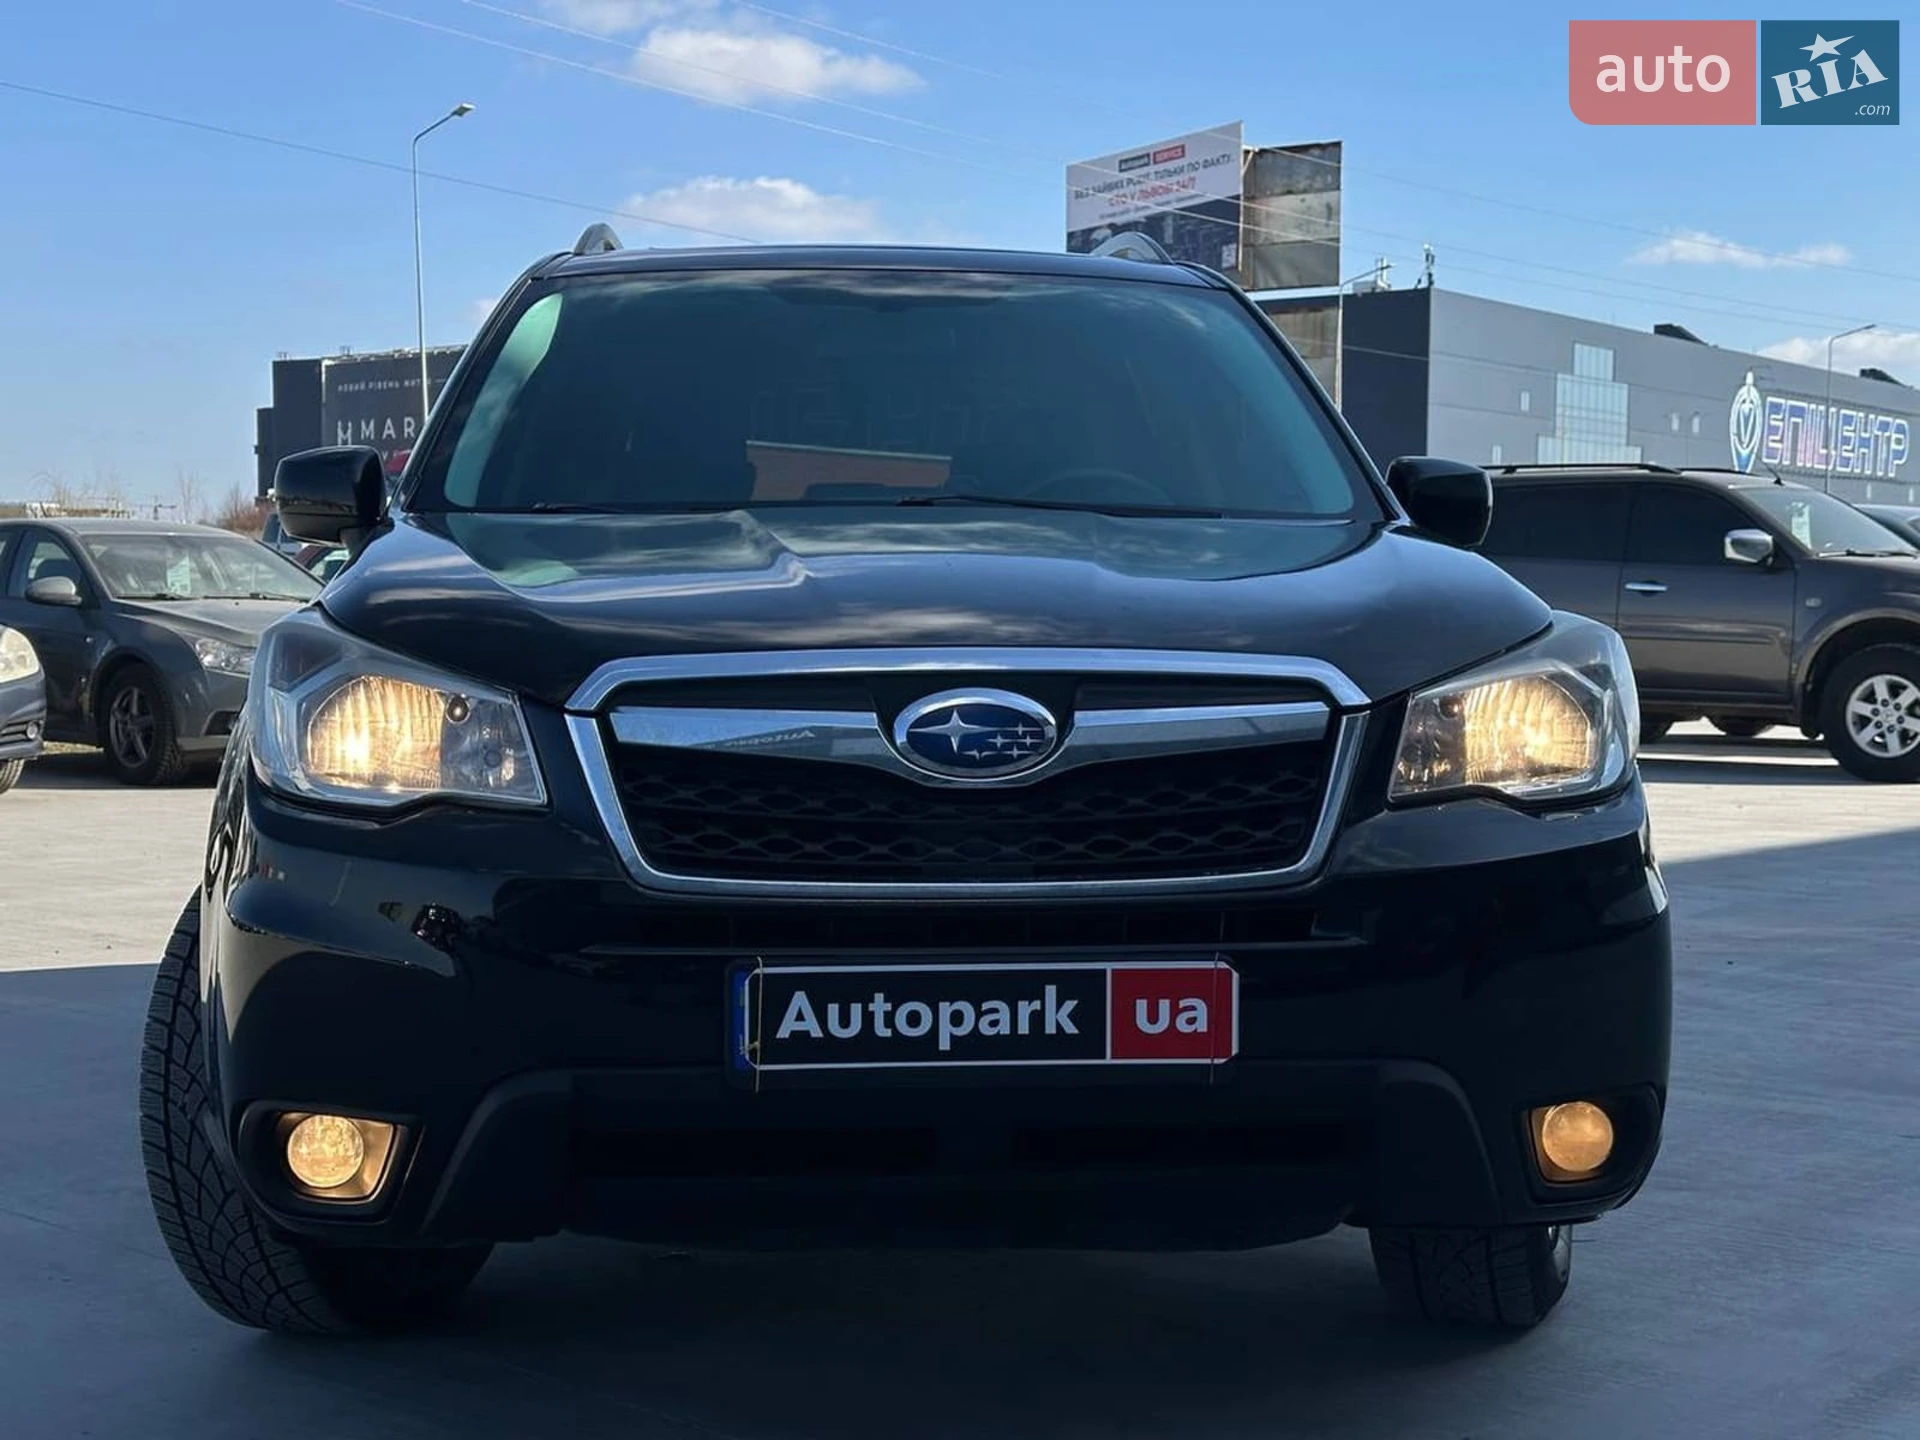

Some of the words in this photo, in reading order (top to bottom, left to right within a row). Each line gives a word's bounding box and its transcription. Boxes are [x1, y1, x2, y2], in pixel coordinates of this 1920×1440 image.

[1762, 397, 1910, 478] ЕПІЦЕНТР
[776, 984, 1080, 1051] Autopark
[1135, 997, 1209, 1033] ua
